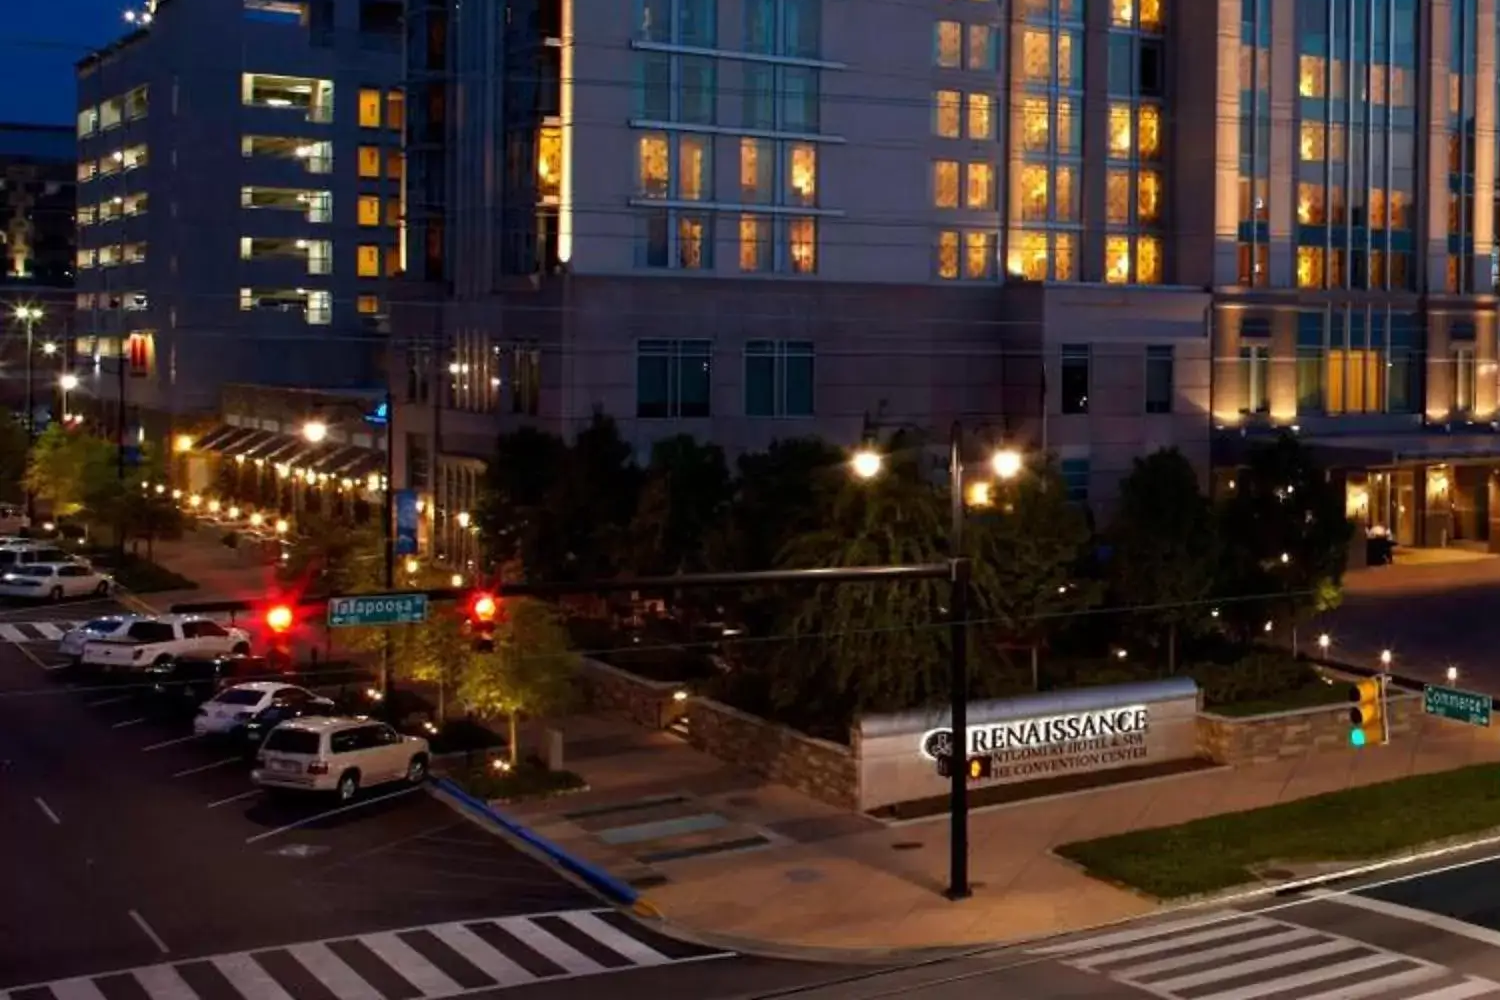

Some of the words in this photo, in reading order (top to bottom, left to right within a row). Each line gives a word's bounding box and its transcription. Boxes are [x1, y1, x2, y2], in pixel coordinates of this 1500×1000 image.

[1427, 687, 1481, 713] Commerce
[972, 709, 1148, 752] RENAISSANCE
[992, 744, 1065, 764] NTGOMERY
[1068, 737, 1107, 754] HOTEL
[1123, 732, 1143, 746] SPA
[1013, 752, 1099, 775] CONVENTION
[1101, 746, 1147, 764] CENTER
